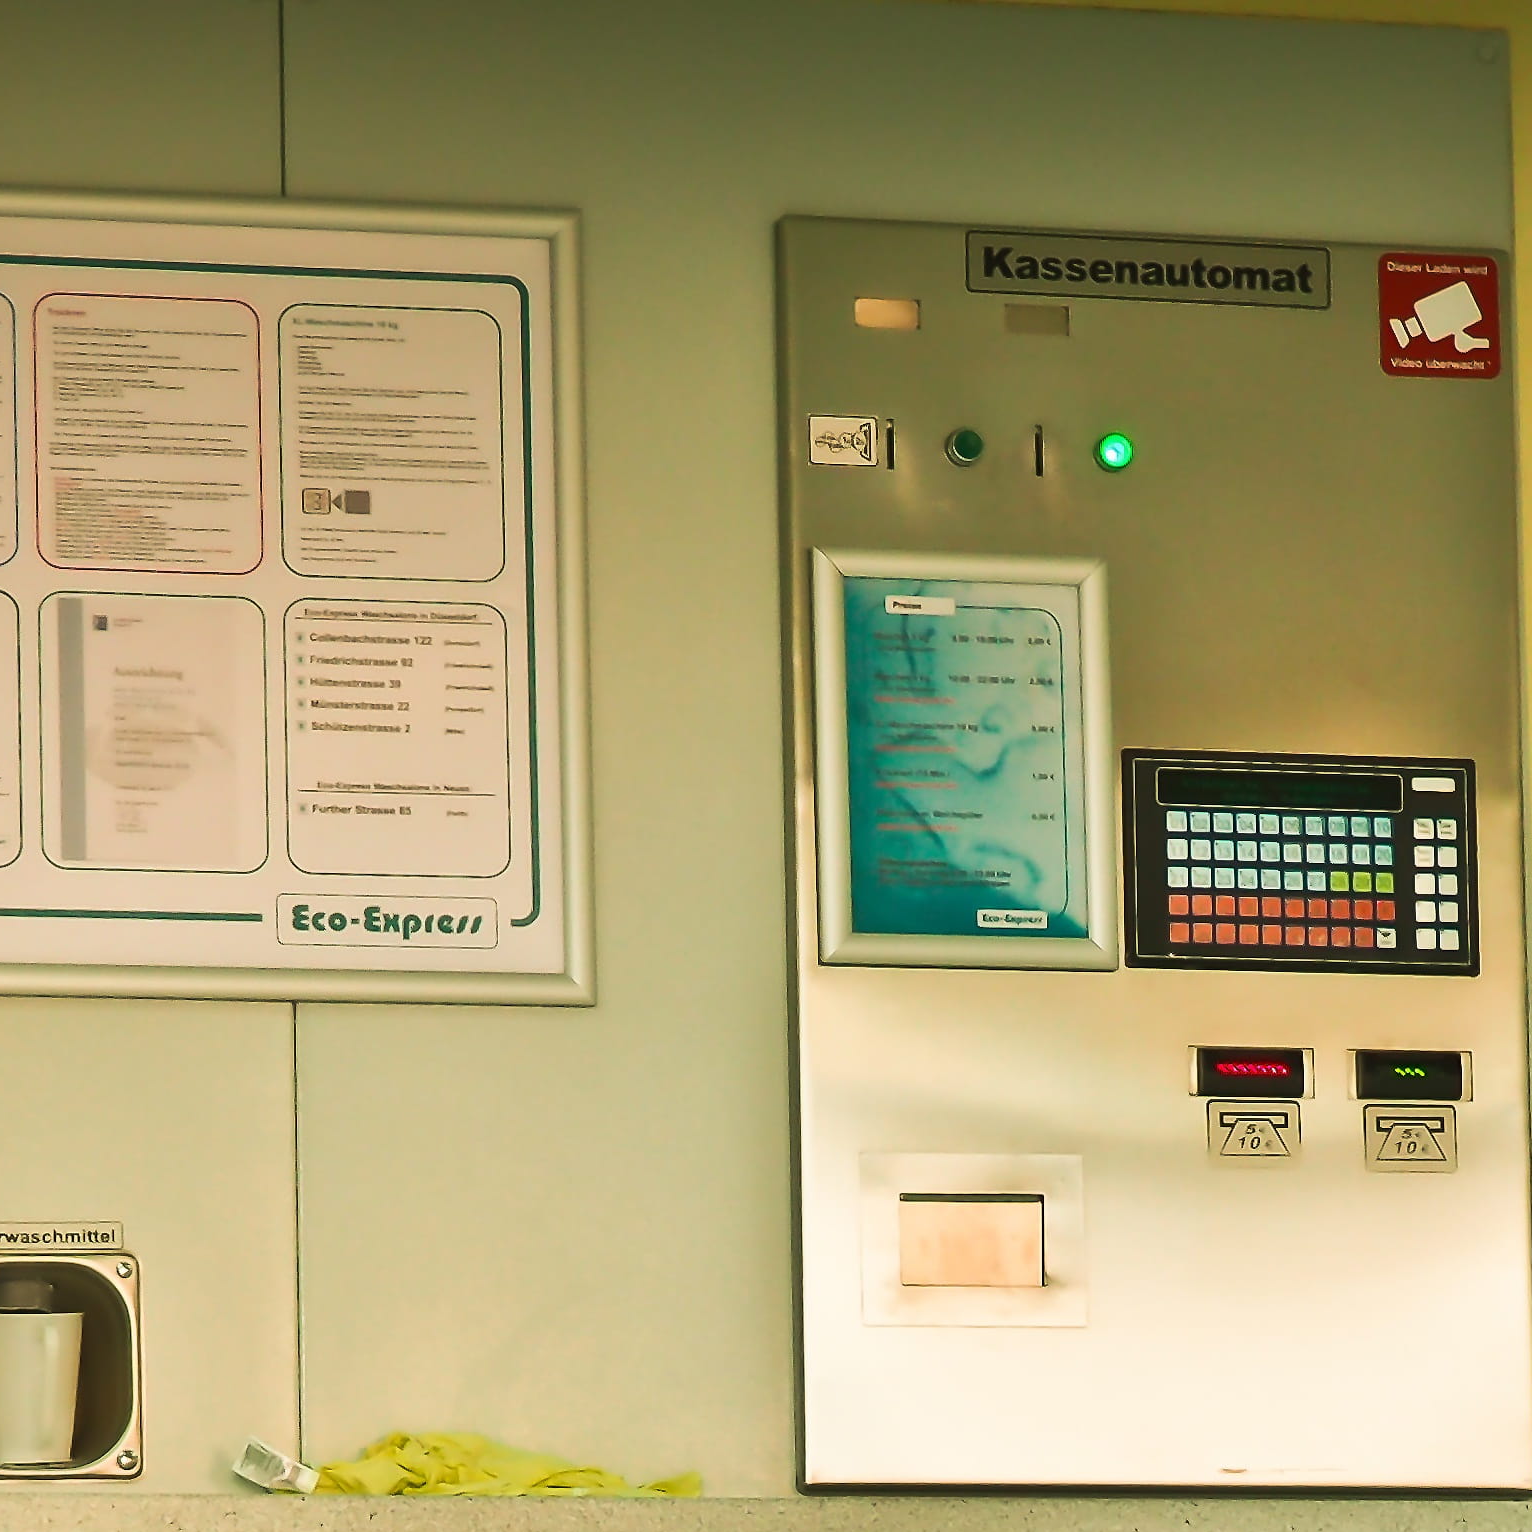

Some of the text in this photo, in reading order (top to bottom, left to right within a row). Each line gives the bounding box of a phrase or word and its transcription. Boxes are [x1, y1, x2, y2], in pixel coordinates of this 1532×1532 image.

[983, 245, 1313, 294] Kassenautomat
[1387, 261, 1488, 275] Dieser Laden wird
[1391, 358, 1422, 367] Video
[310, 654, 398, 667] Friedrichstrasse
[356, 805, 396, 815] Strasse
[292, 904, 482, 940] Eco-Express
[1245, 1124, 1256, 1134] 5
[1401, 1129, 1412, 1138] 5
[1238, 1136, 1261, 1149] 10
[1395, 1141, 1417, 1154] 10
